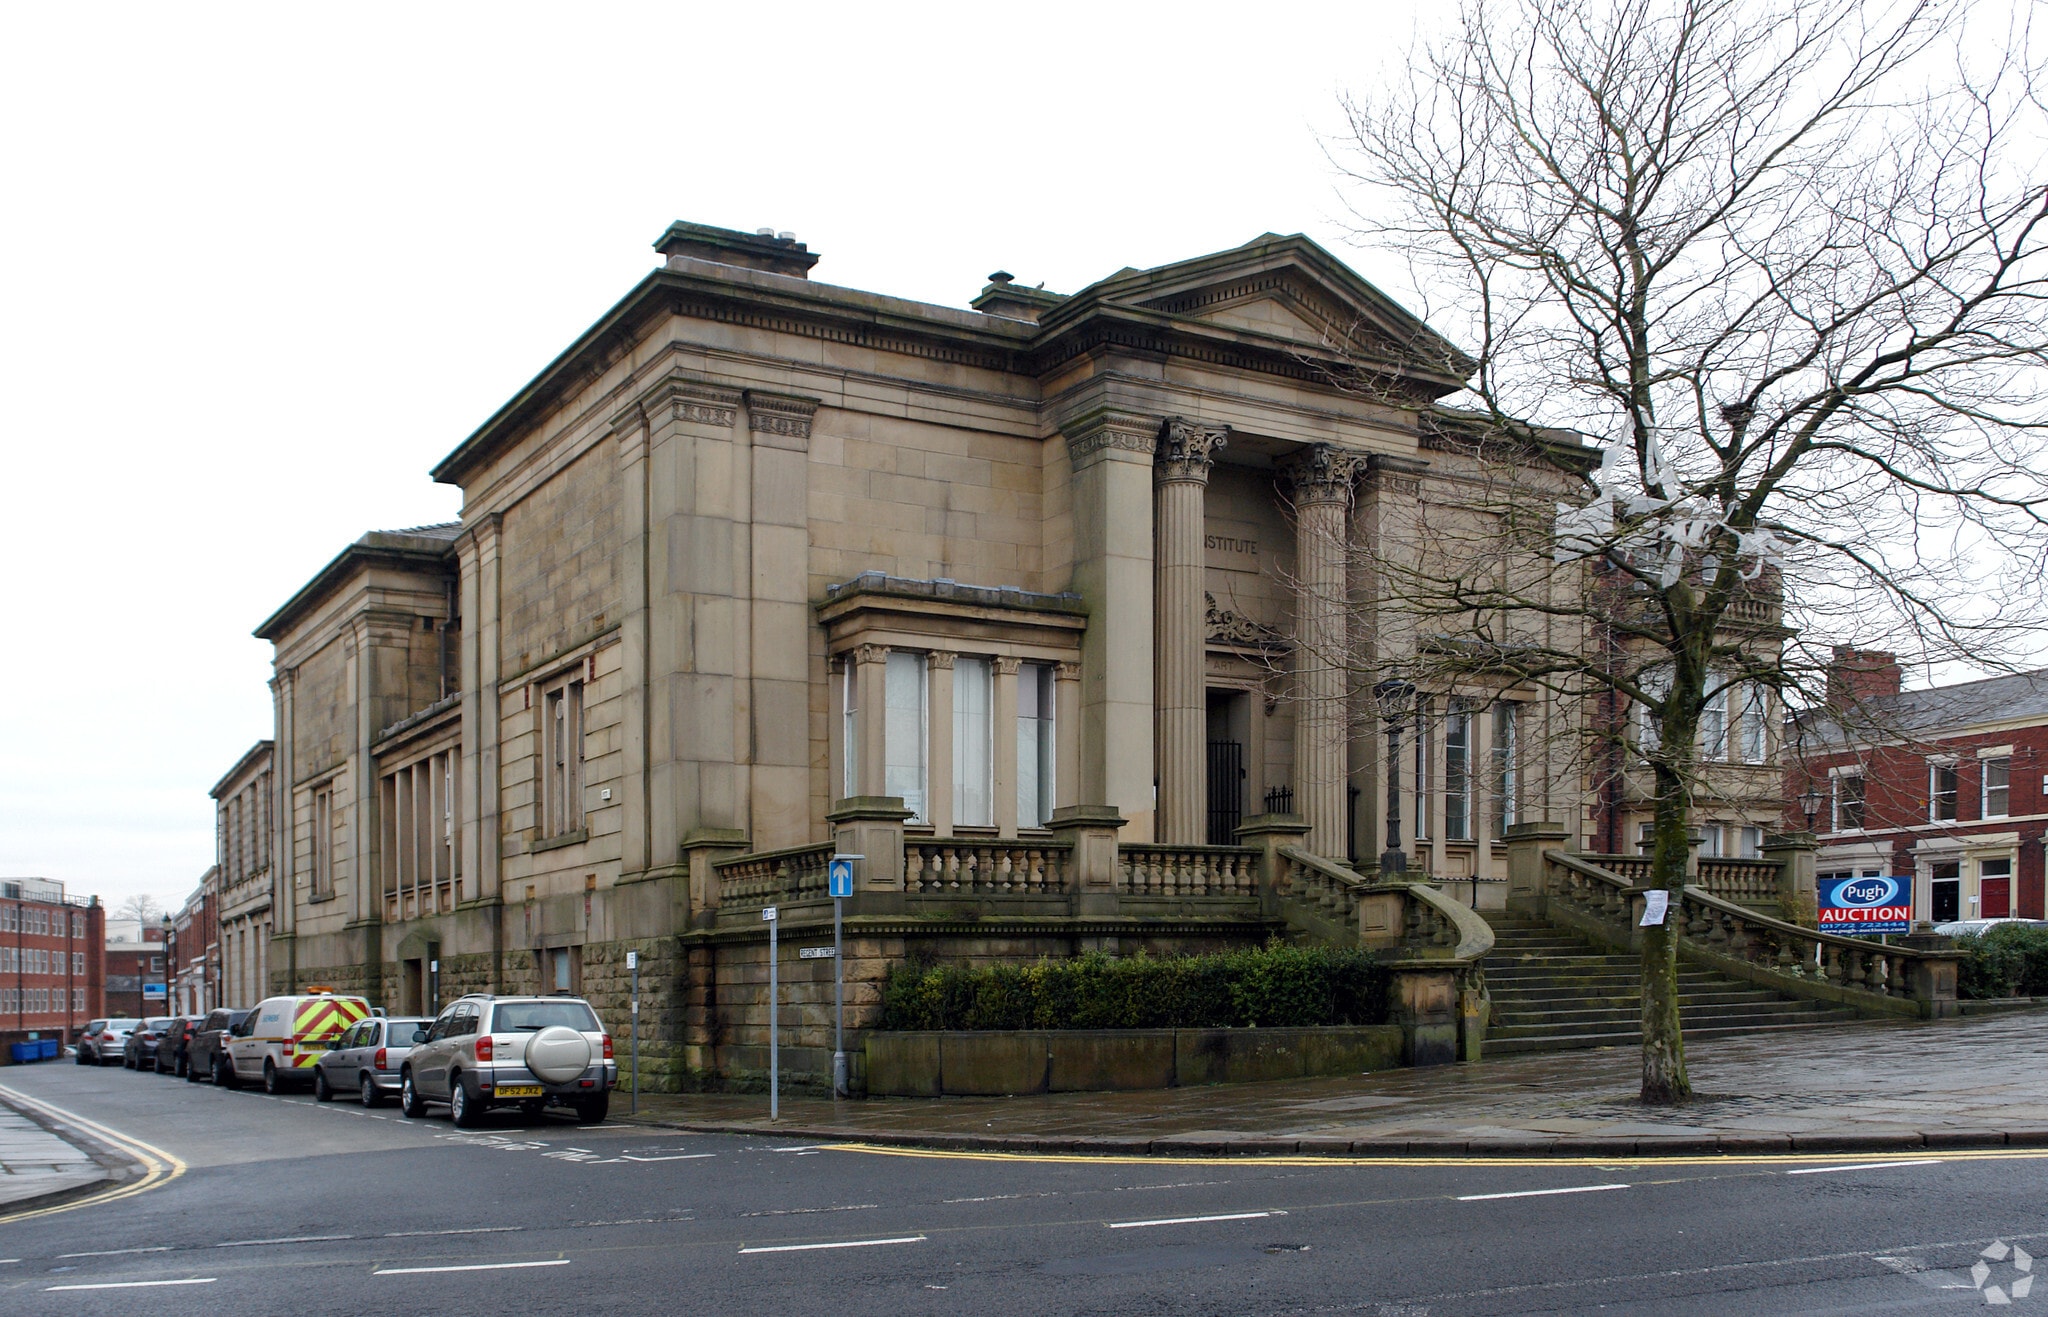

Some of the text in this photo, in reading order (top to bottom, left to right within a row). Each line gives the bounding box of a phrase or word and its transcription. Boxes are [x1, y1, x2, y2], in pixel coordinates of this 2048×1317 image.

[1204, 534, 1257, 554] STITUTE
[1847, 884, 1884, 901] Pugh
[1821, 907, 1907, 922] AUCTION
[819, 947, 836, 957] STREE
[498, 1087, 521, 1095] DF52
